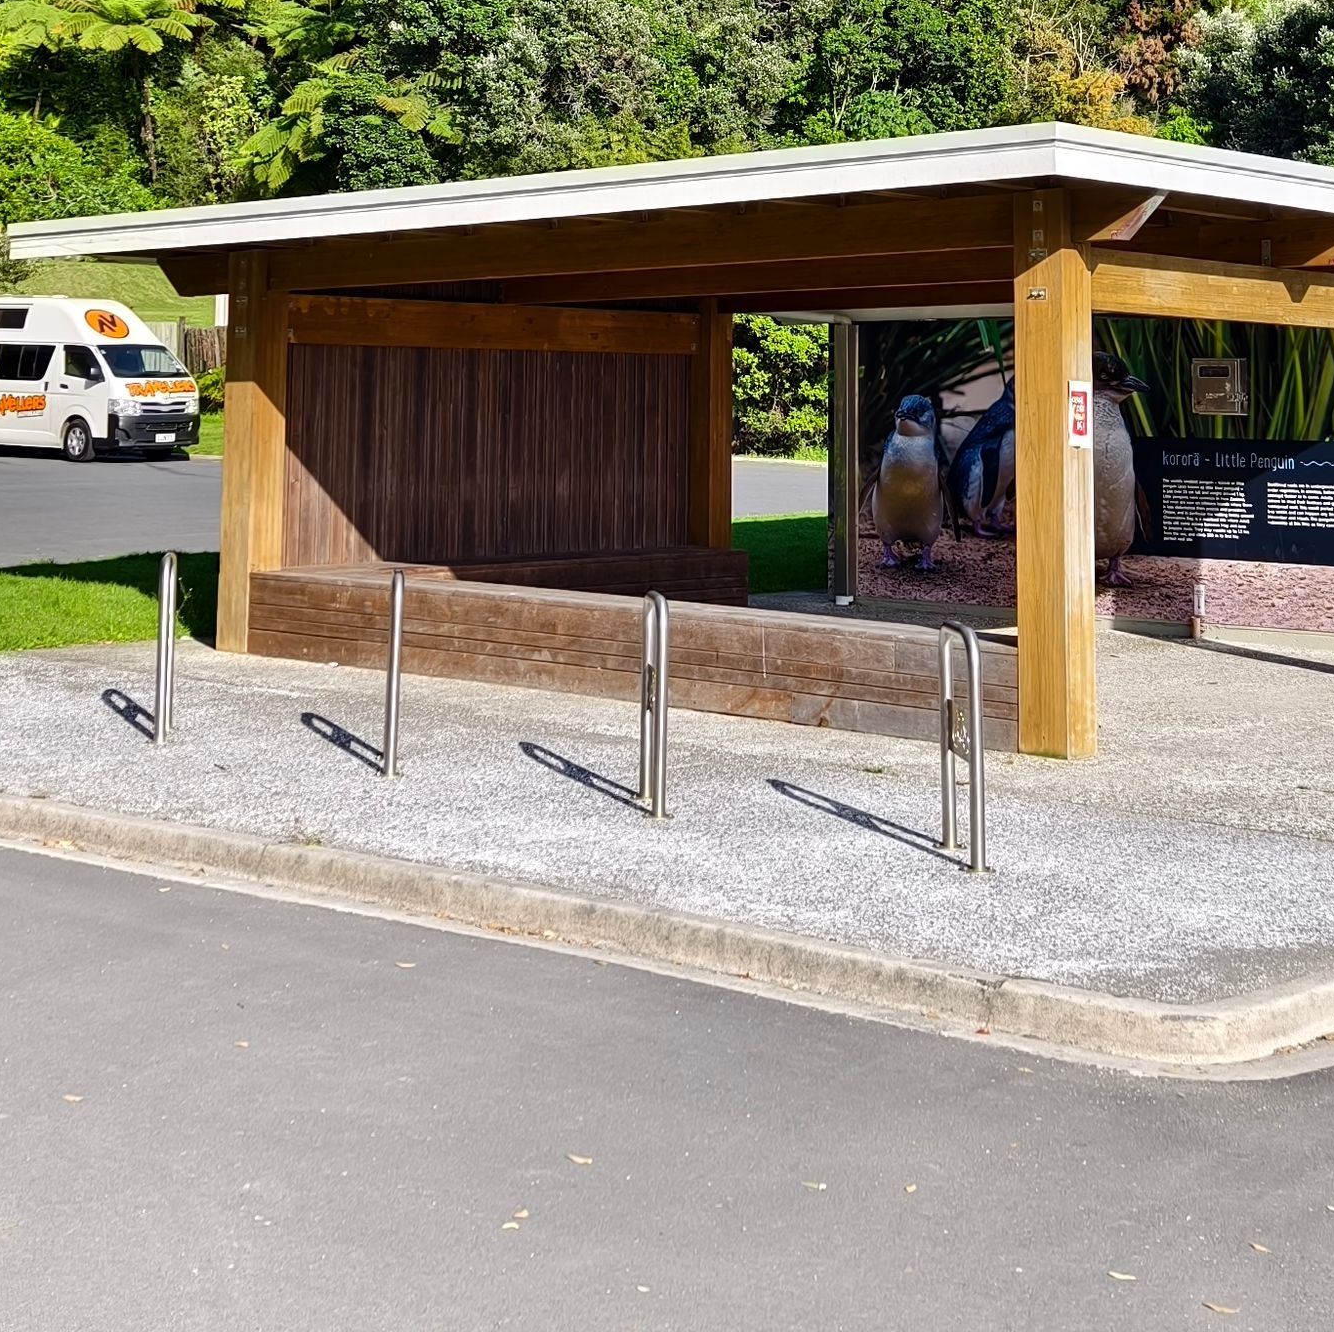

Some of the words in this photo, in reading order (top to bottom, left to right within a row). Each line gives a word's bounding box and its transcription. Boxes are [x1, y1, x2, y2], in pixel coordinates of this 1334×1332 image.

[1162, 450, 1200, 467] kororā
[1215, 452, 1246, 468] Little
[1250, 453, 1295, 471] Penguin
